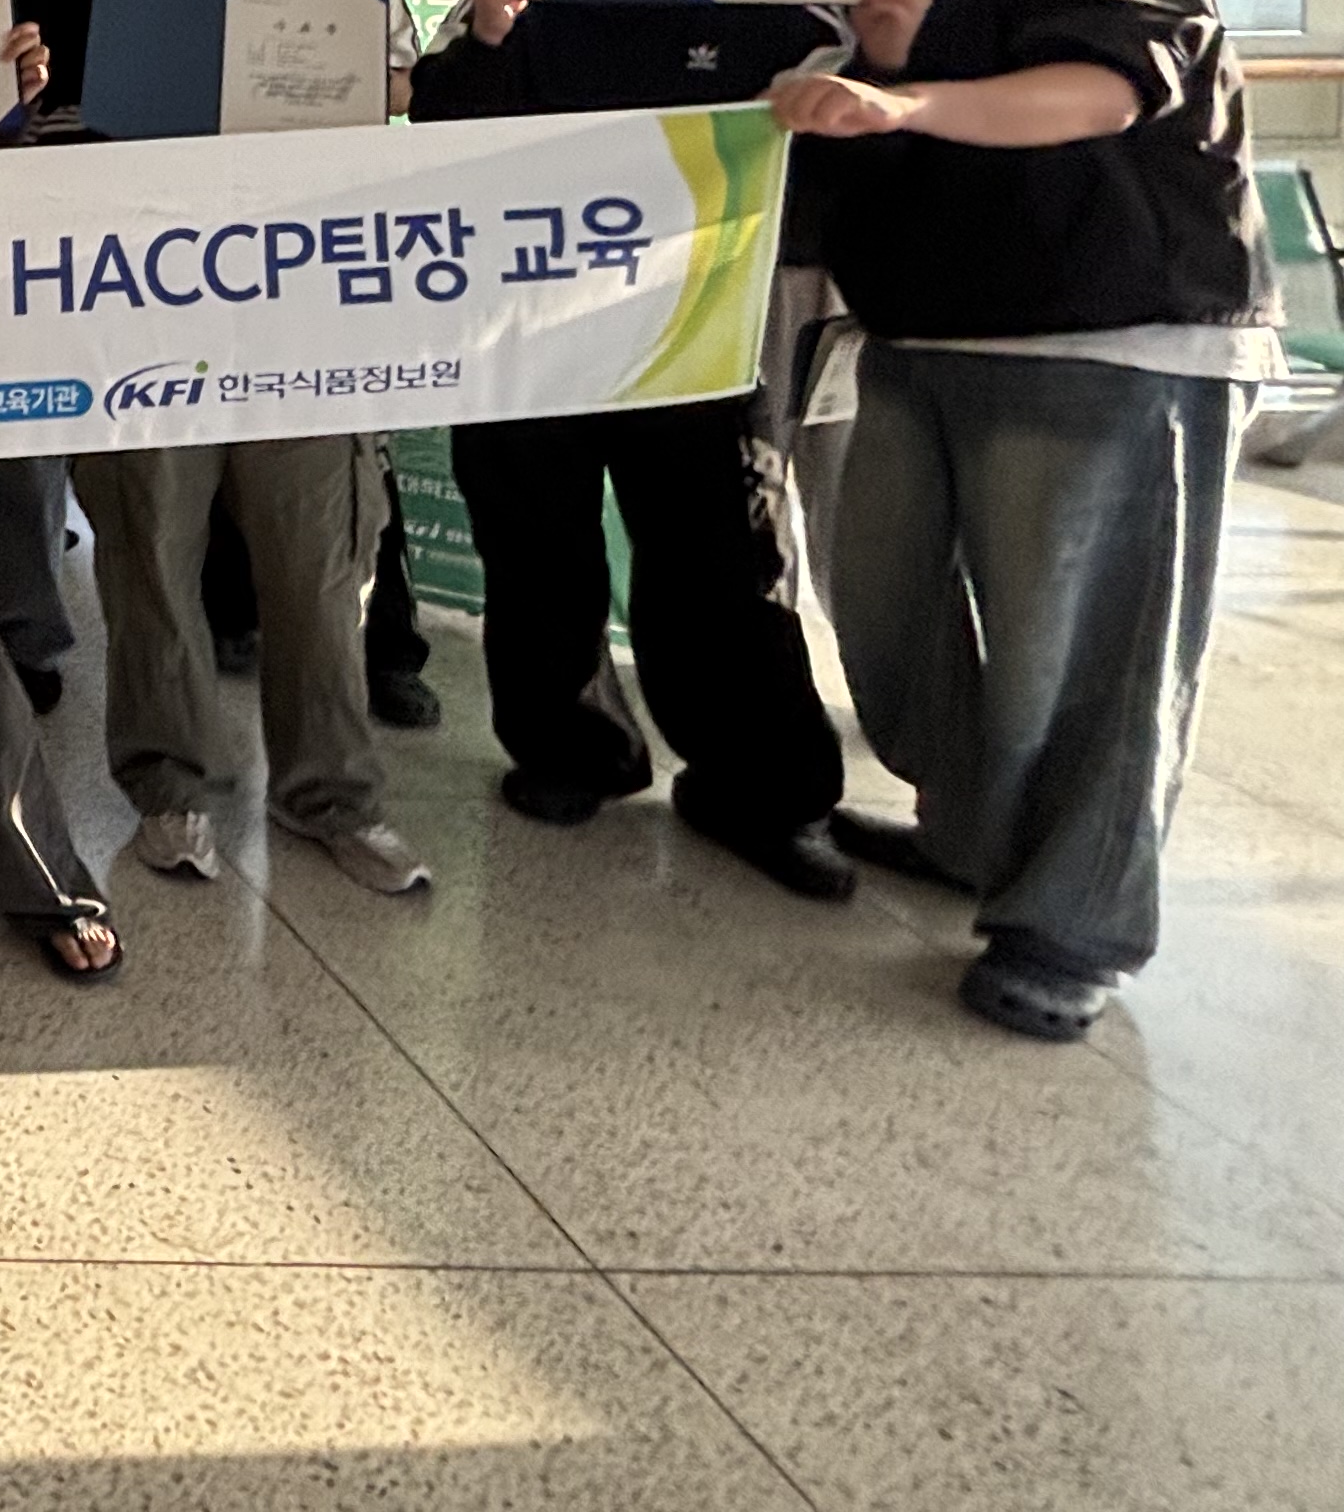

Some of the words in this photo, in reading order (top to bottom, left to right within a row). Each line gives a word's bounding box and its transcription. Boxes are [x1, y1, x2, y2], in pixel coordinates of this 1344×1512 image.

[12, 207, 475, 316] HACCP팀장
[501, 196, 653, 286] 교육
[219, 358, 462, 403] 한국식품정보원
